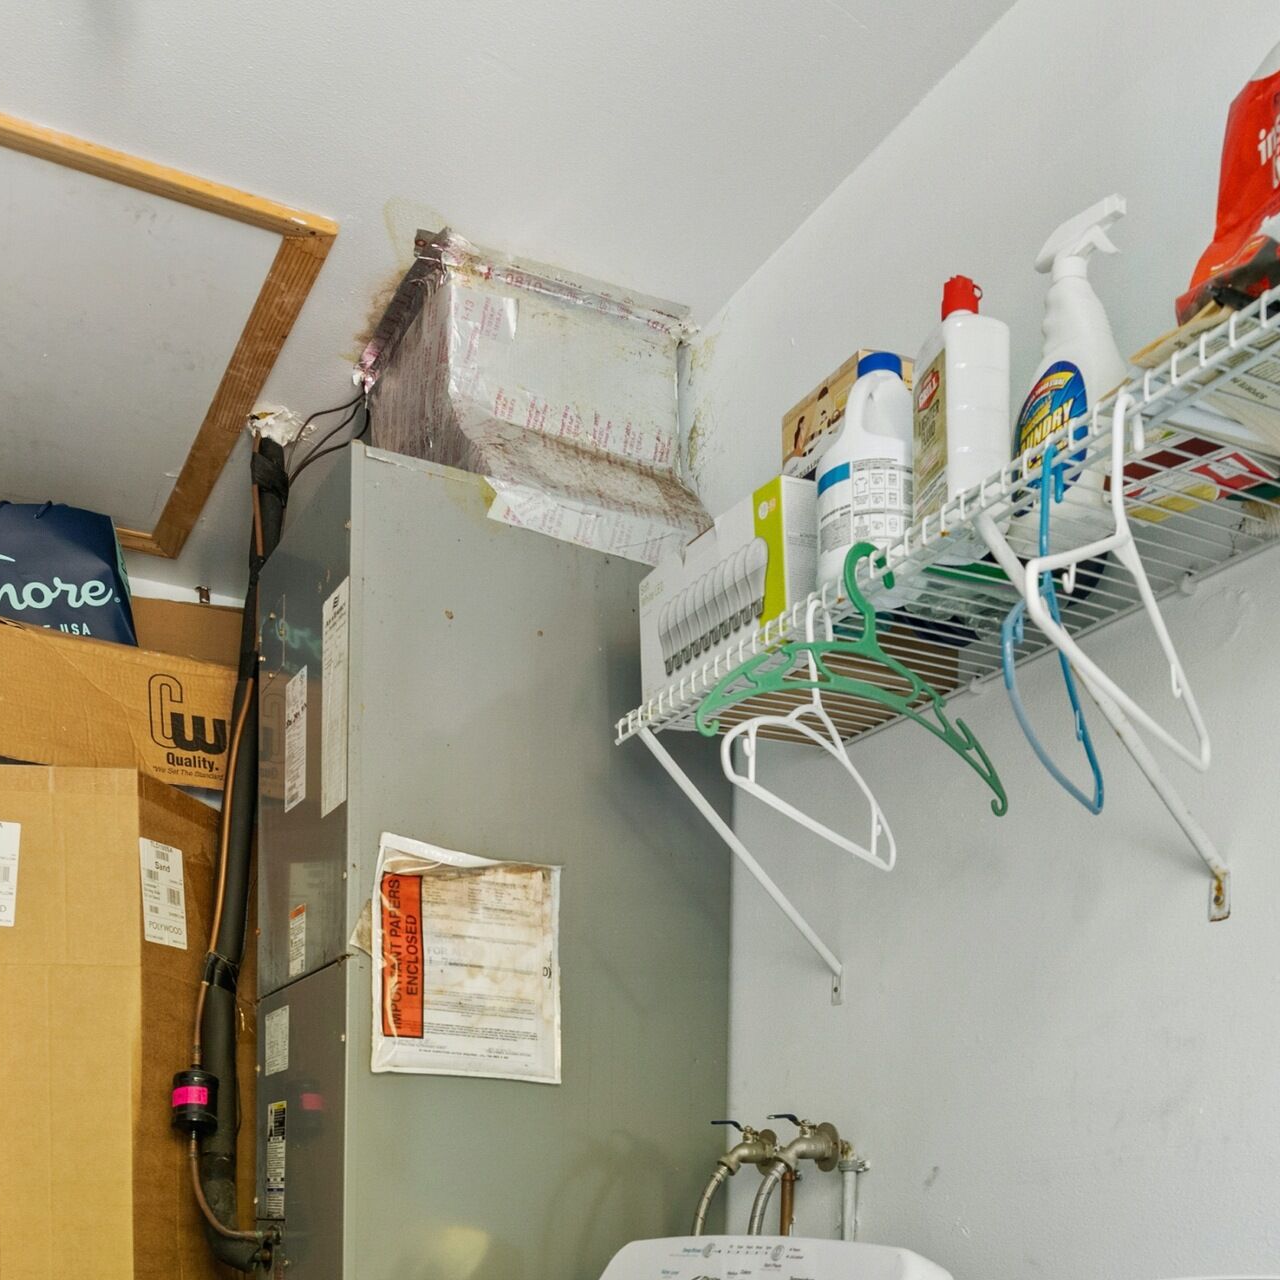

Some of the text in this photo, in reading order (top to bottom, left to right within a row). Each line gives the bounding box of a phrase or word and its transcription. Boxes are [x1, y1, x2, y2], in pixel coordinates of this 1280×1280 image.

[60, 622, 92, 636] USA
[166, 751, 220, 773] Quality.
[180, 769, 194, 777] The
[154, 861, 171, 873] Sand
[388, 878, 402, 937] PAPERS
[148, 920, 184, 936] POLYWOOD
[405, 914, 419, 997] ENCLOSED
